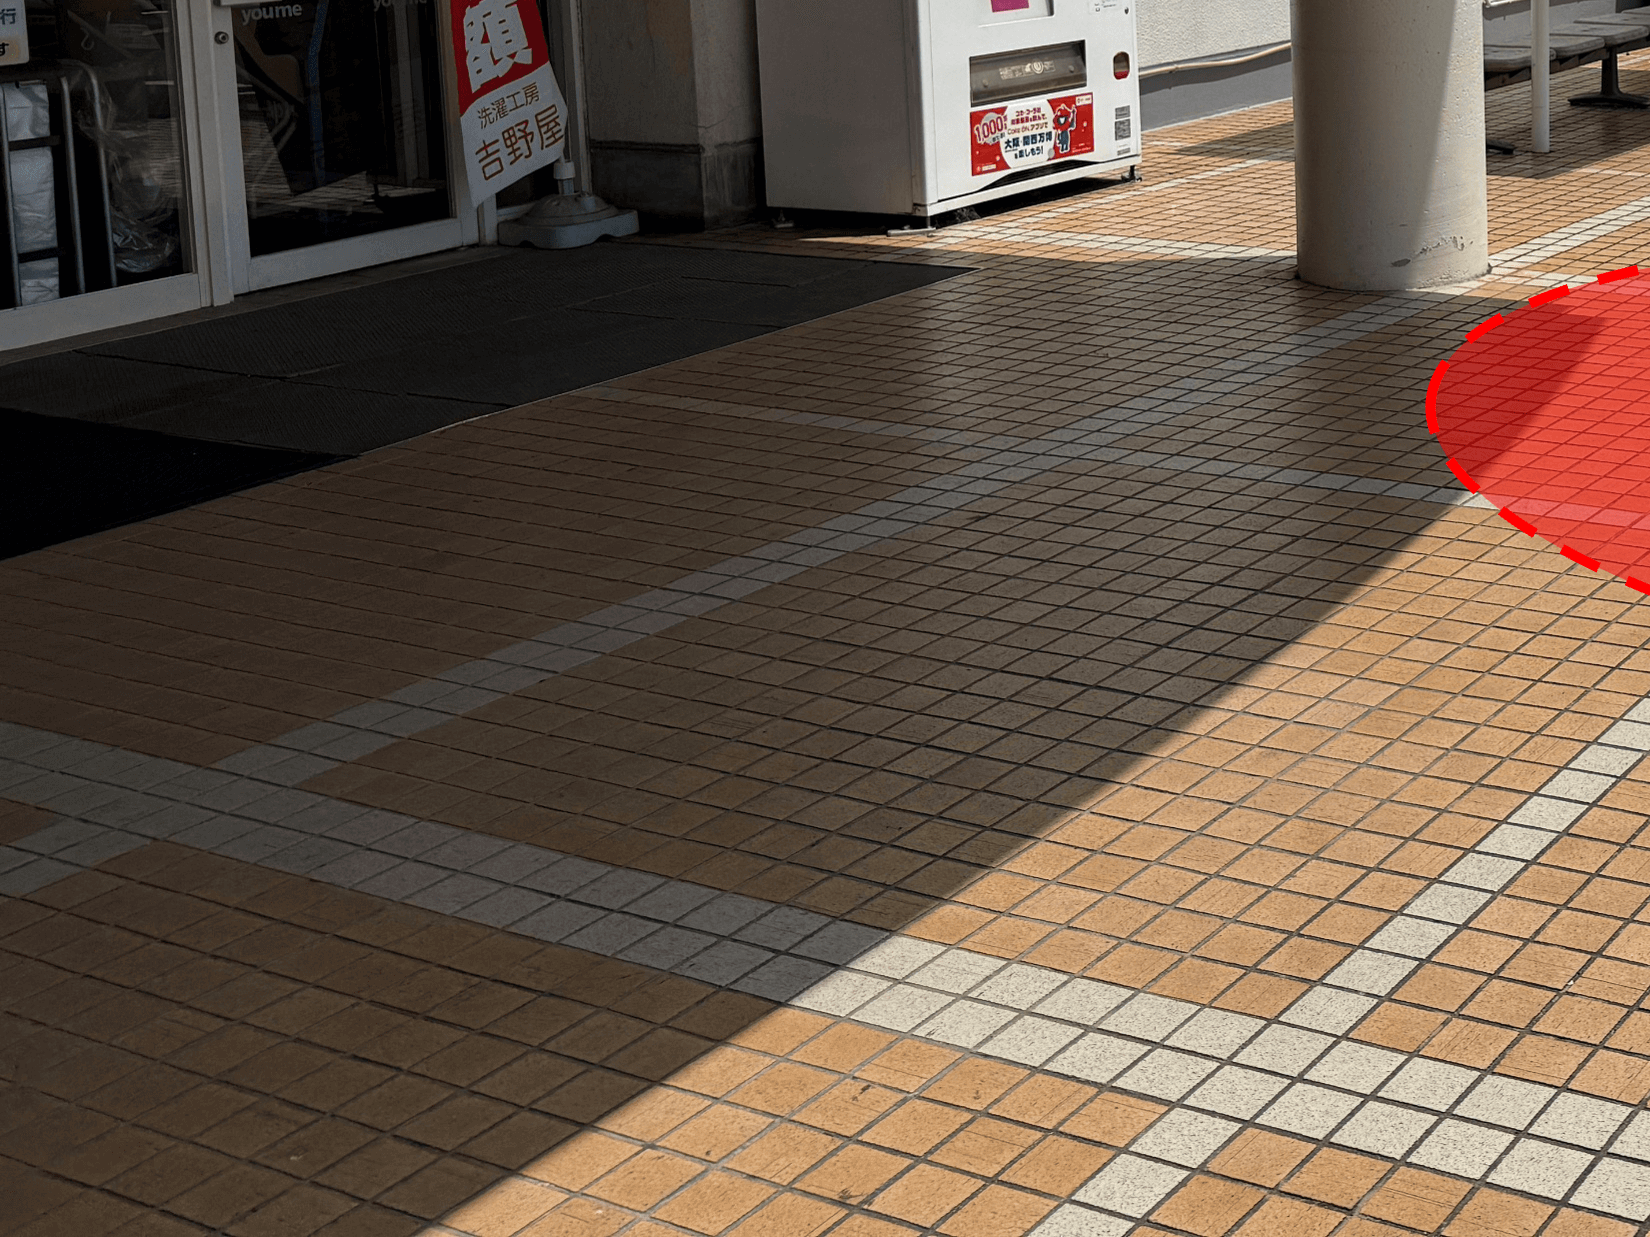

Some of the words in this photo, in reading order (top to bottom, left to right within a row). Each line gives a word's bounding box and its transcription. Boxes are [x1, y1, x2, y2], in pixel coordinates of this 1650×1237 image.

[241, 3, 303, 26] youme
[477, 81, 541, 129] 洗濯工房
[475, 103, 564, 182] 吉野屋
[975, 115, 1004, 142] 1,000
